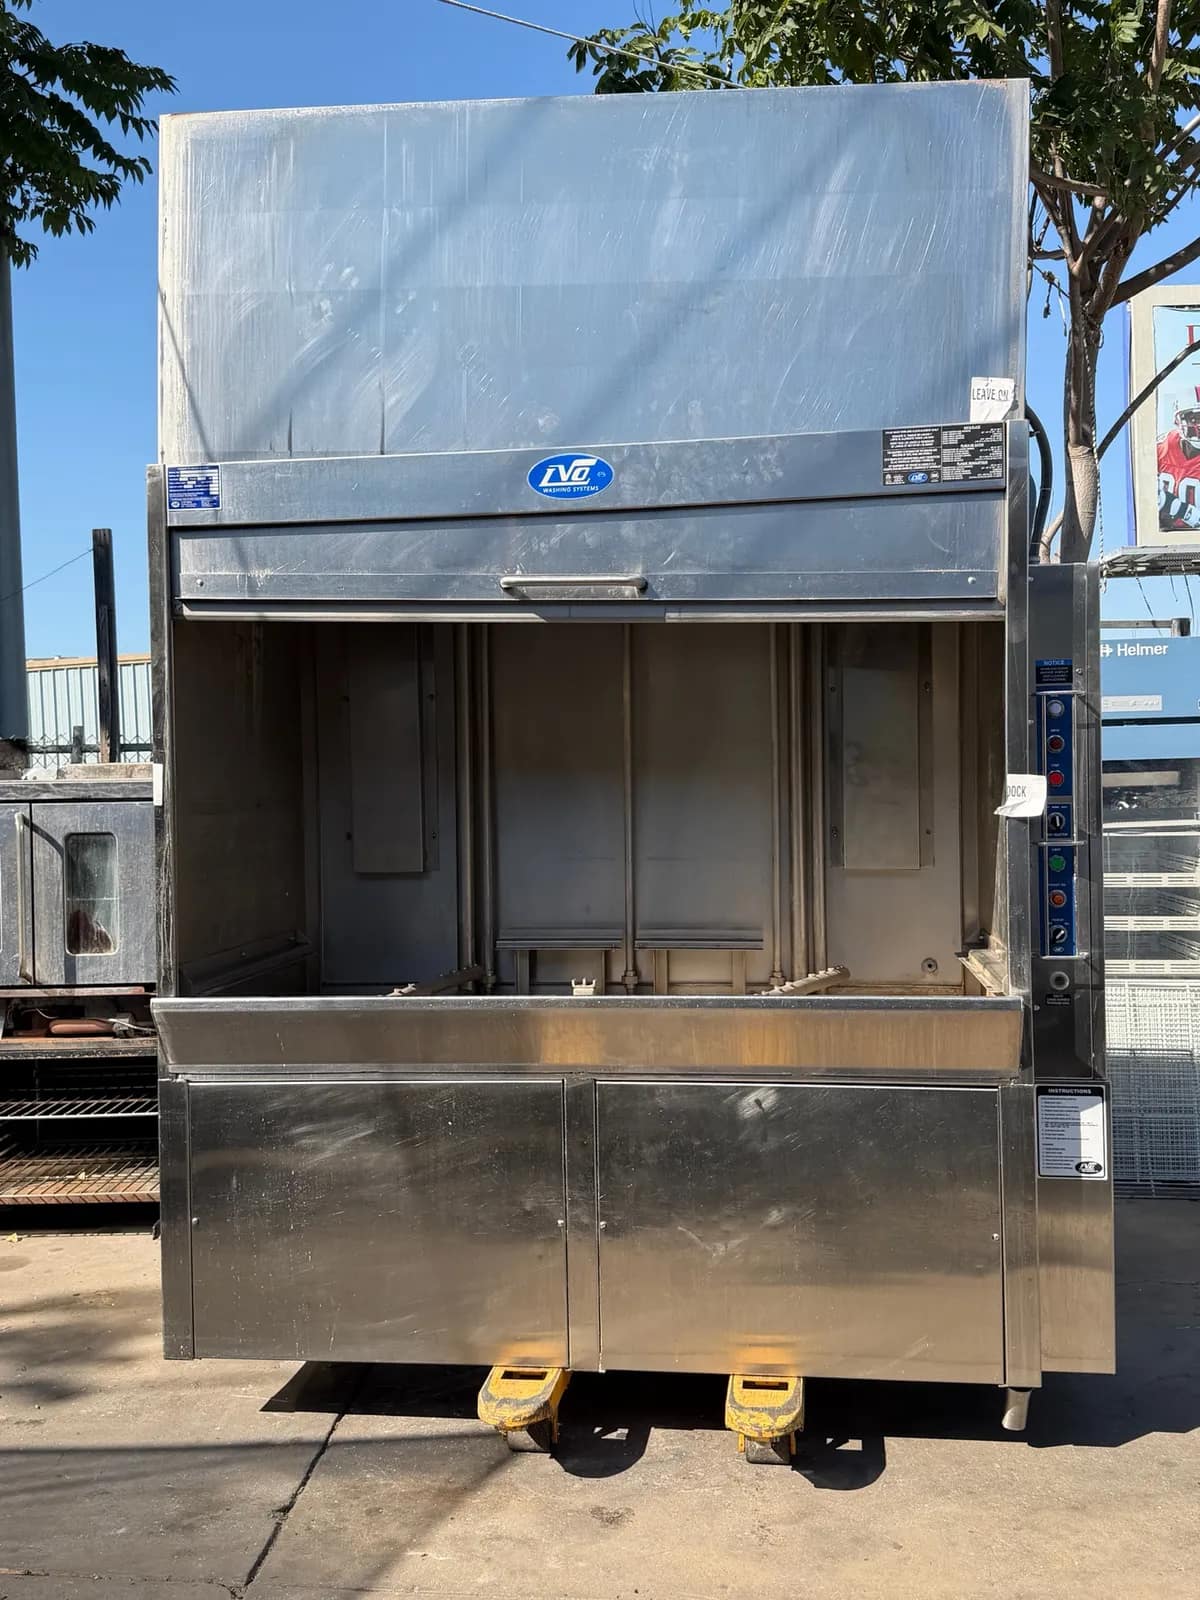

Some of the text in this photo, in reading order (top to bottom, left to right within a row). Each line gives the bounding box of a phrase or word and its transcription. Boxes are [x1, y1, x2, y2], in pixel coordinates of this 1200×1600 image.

[972, 388, 995, 400] LEAVE
[573, 485, 599, 493] SYSTEMS
[1117, 643, 1168, 657] Helmer
